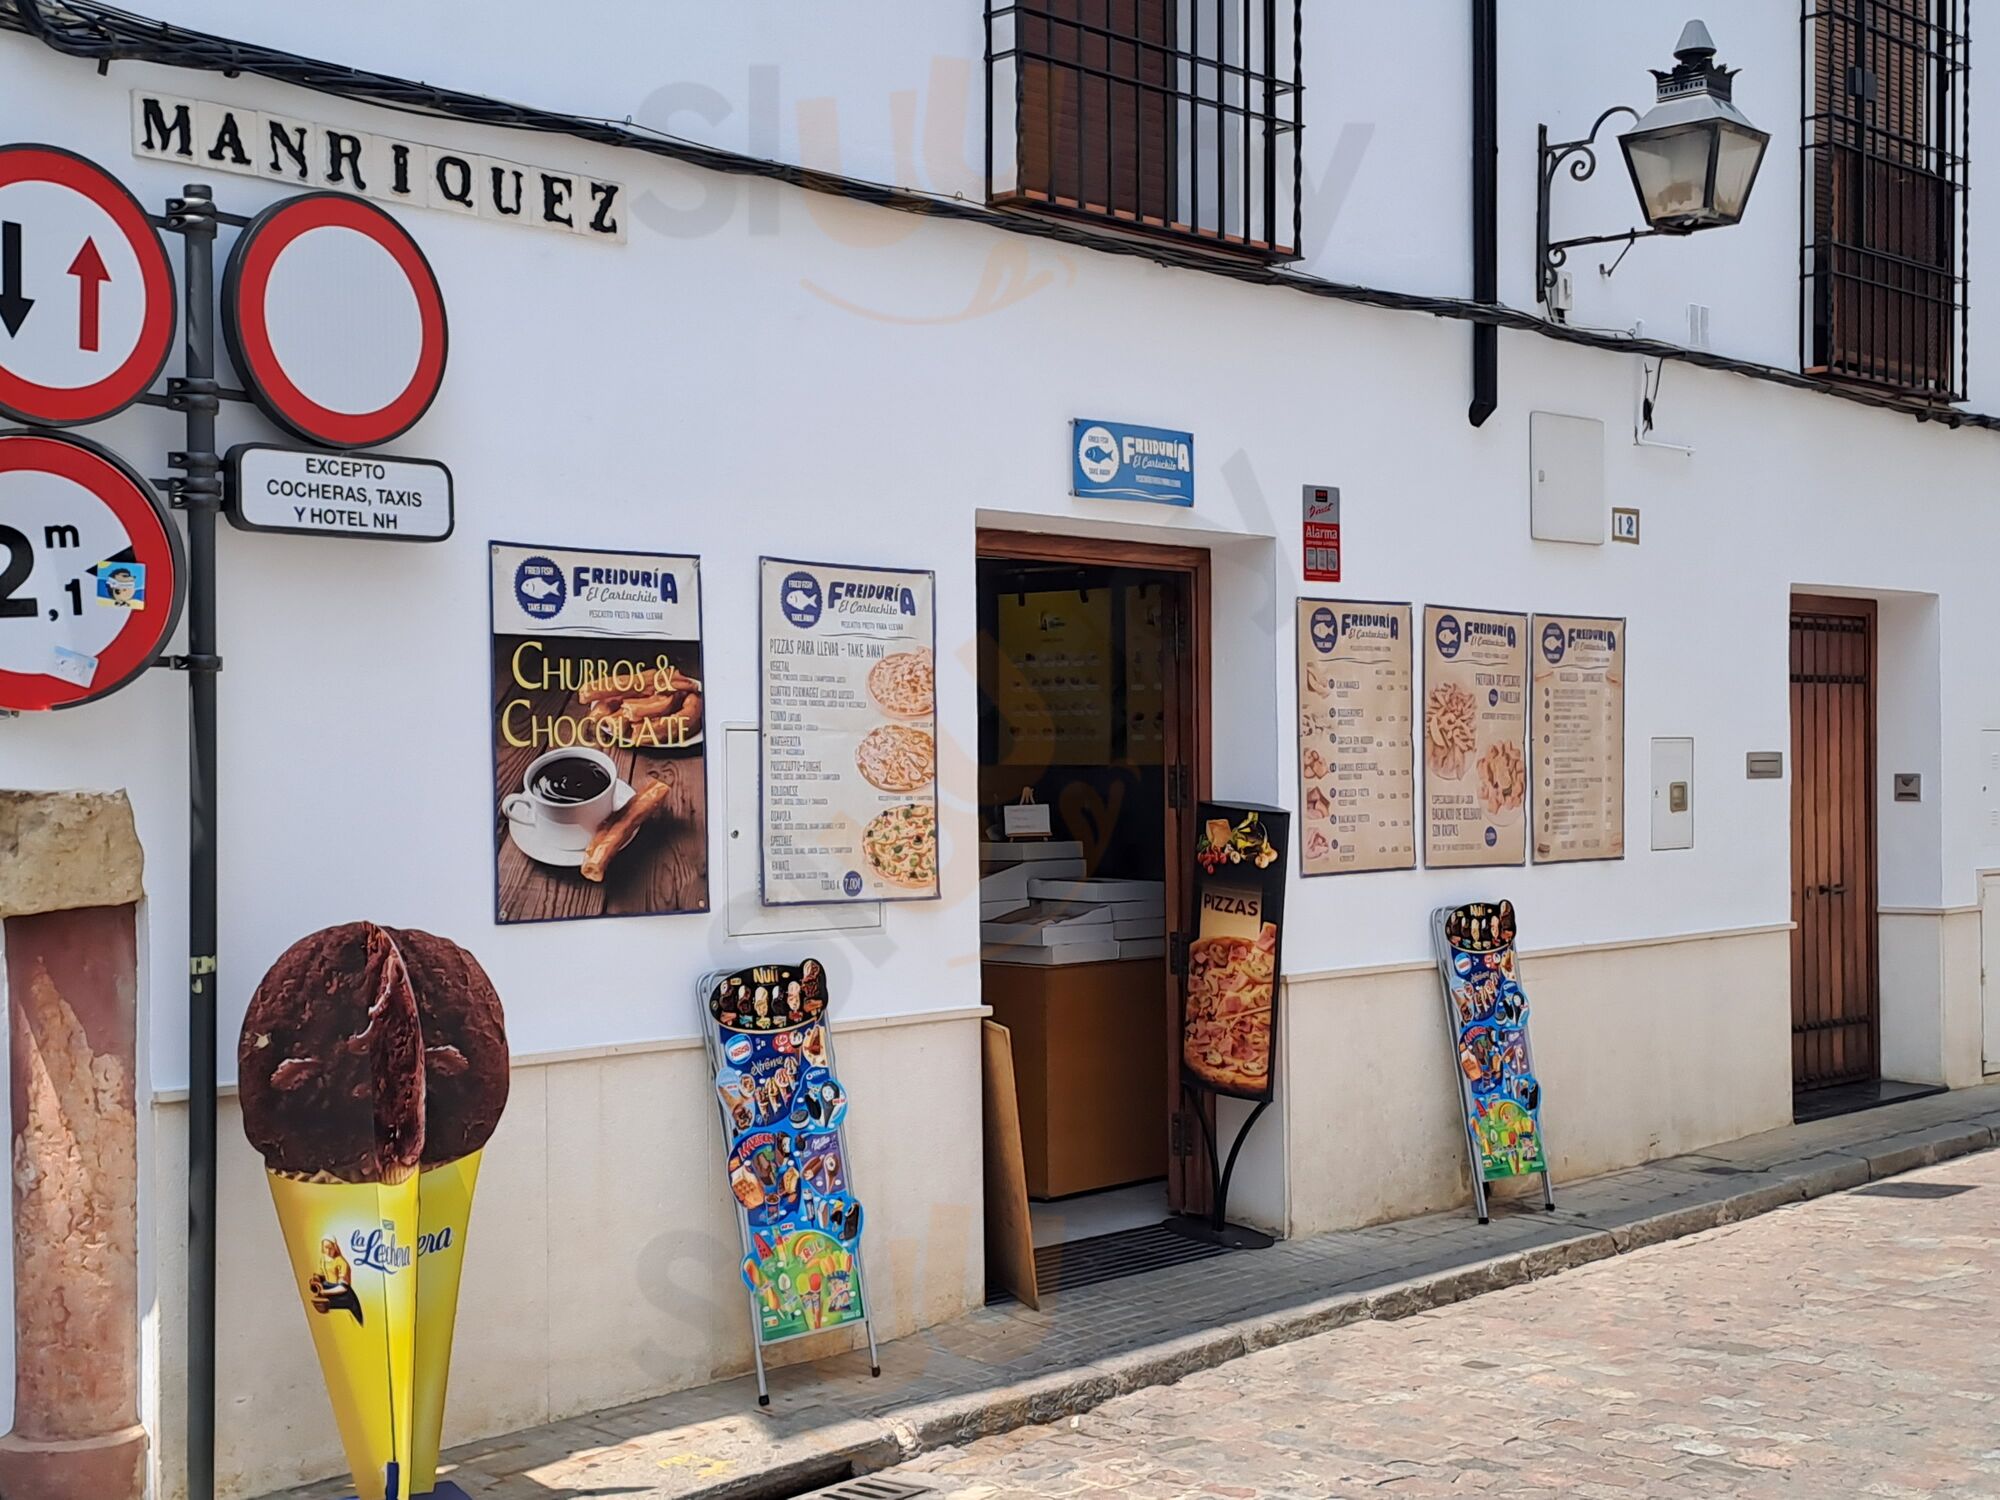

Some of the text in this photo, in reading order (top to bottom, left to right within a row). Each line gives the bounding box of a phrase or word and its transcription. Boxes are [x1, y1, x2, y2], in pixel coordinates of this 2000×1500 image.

[142, 98, 618, 234] MANRIQUEZ
[305, 458, 385, 479] EXCEPTO
[266, 479, 422, 508] COCHERAS, TAXIS
[293, 507, 398, 530] Y HOTEL NH
[1618, 515, 1634, 536] 12
[1306, 525, 1338, 540] Alarma
[573, 566, 678, 604] FREIDURÍA
[586, 587, 598, 601] El
[828, 581, 916, 616] FREIDURÍA
[838, 600, 848, 613] El
[769, 639, 794, 654] PIZZAS
[797, 639, 815, 655] PARA
[816, 640, 839, 656] LLEVAR
[848, 642, 864, 658] TAKE
[866, 643, 885, 659] AWAY
[512, 641, 678, 692] CHURROS &
[502, 699, 690, 748] CHOCOLATE
[1204, 893, 1258, 917] PIZZAS
